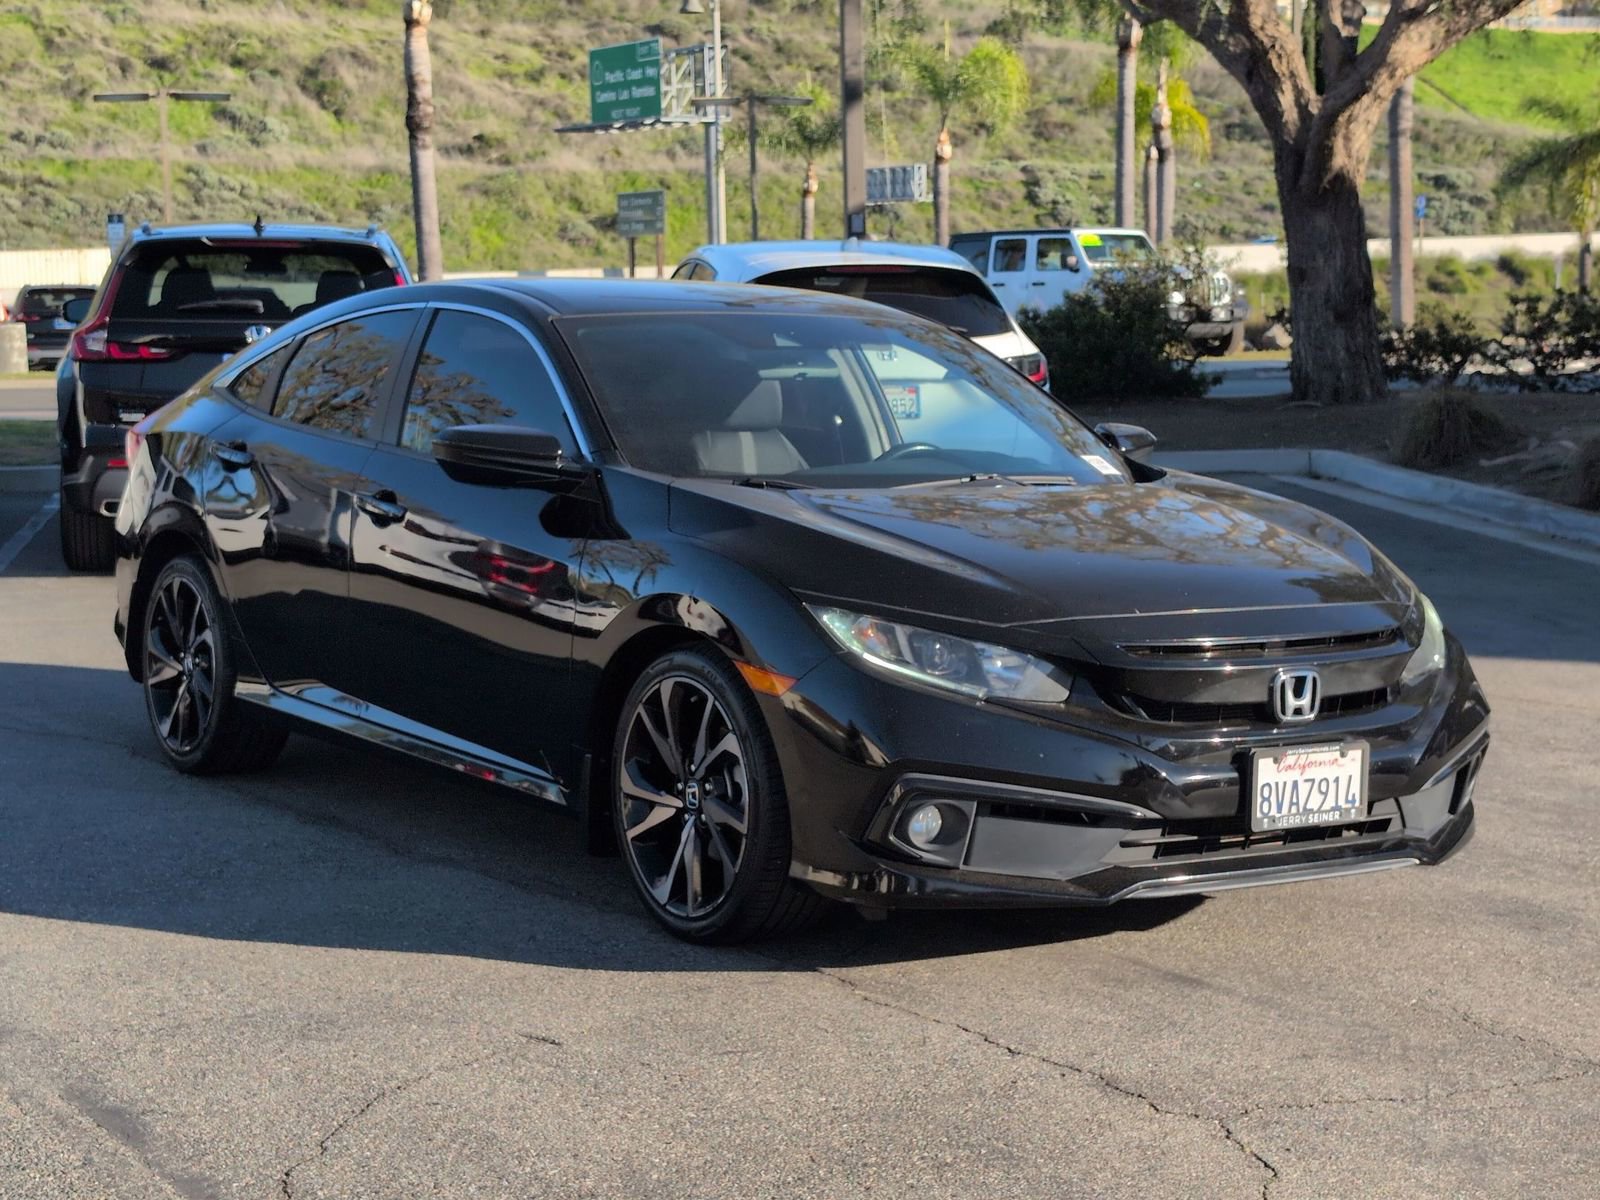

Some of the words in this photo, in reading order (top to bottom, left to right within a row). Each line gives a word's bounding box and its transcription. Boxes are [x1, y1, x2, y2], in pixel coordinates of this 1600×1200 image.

[1277, 751, 1344, 776] California
[1259, 774, 1357, 817] 8VAZ914
[1278, 815, 1307, 827] JERRY
[1308, 811, 1340, 824] SEINER
